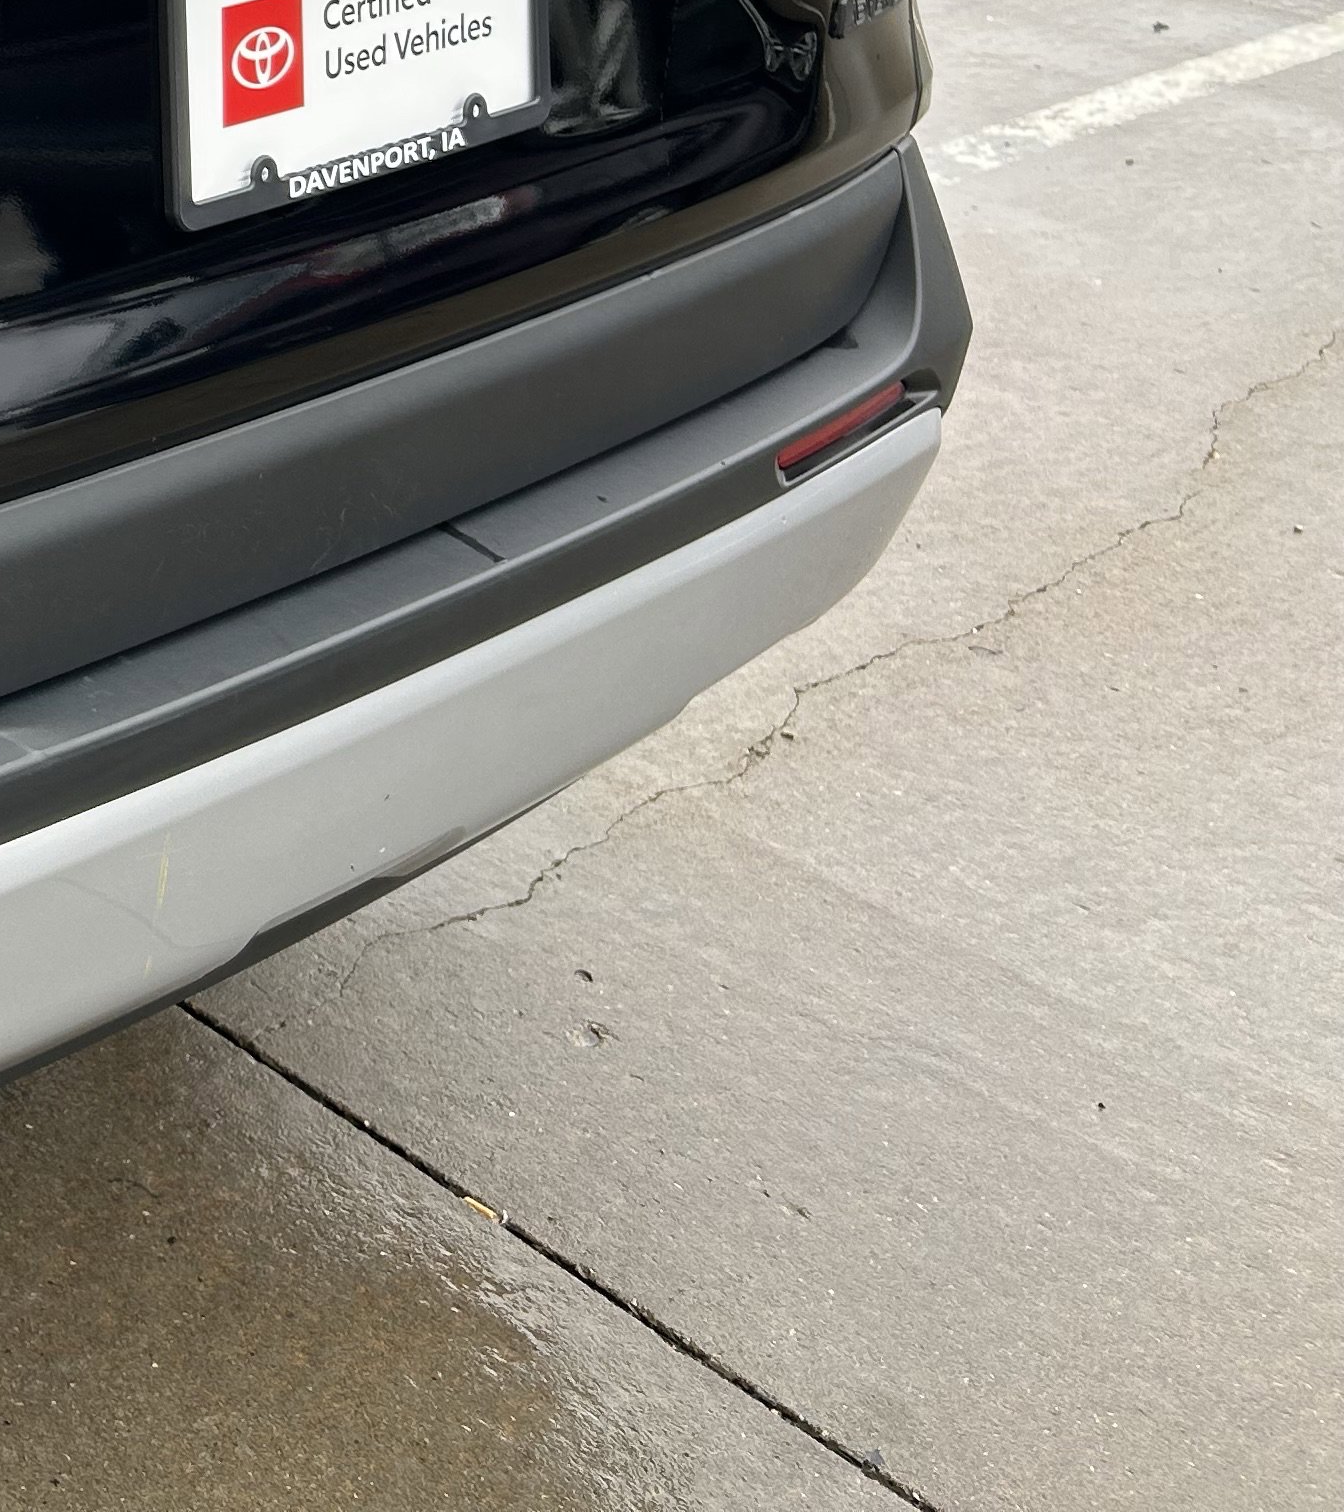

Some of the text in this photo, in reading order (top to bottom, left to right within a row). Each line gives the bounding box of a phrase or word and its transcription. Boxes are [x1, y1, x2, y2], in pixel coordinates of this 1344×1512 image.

[325, 13, 493, 79] Used Vehicles
[288, 128, 466, 199] DAVENPORT, IA
